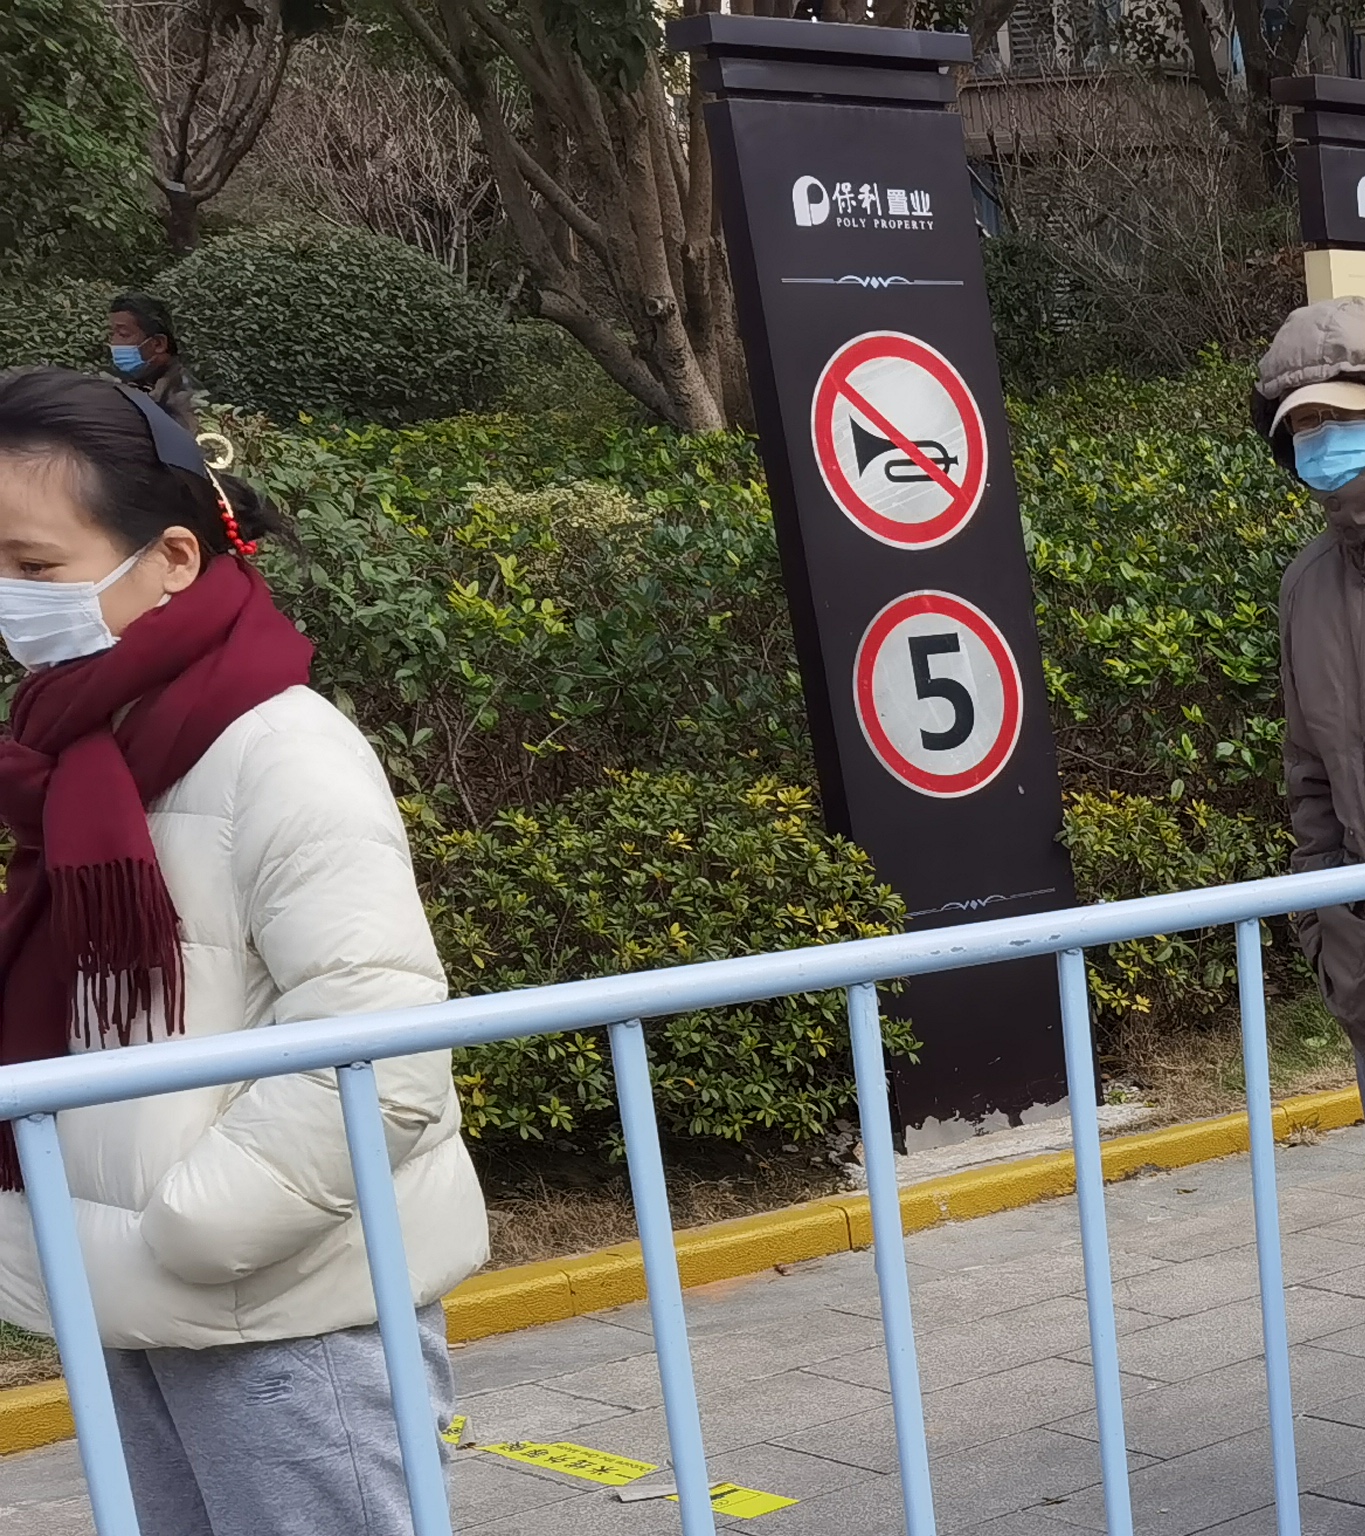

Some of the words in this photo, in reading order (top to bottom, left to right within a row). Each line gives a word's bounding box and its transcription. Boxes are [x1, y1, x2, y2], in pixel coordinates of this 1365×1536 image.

[832, 182, 934, 216] 保利置业
[836, 217, 867, 228] POLY
[873, 218, 934, 230] PROPERTY
[908, 631, 976, 752] 5
